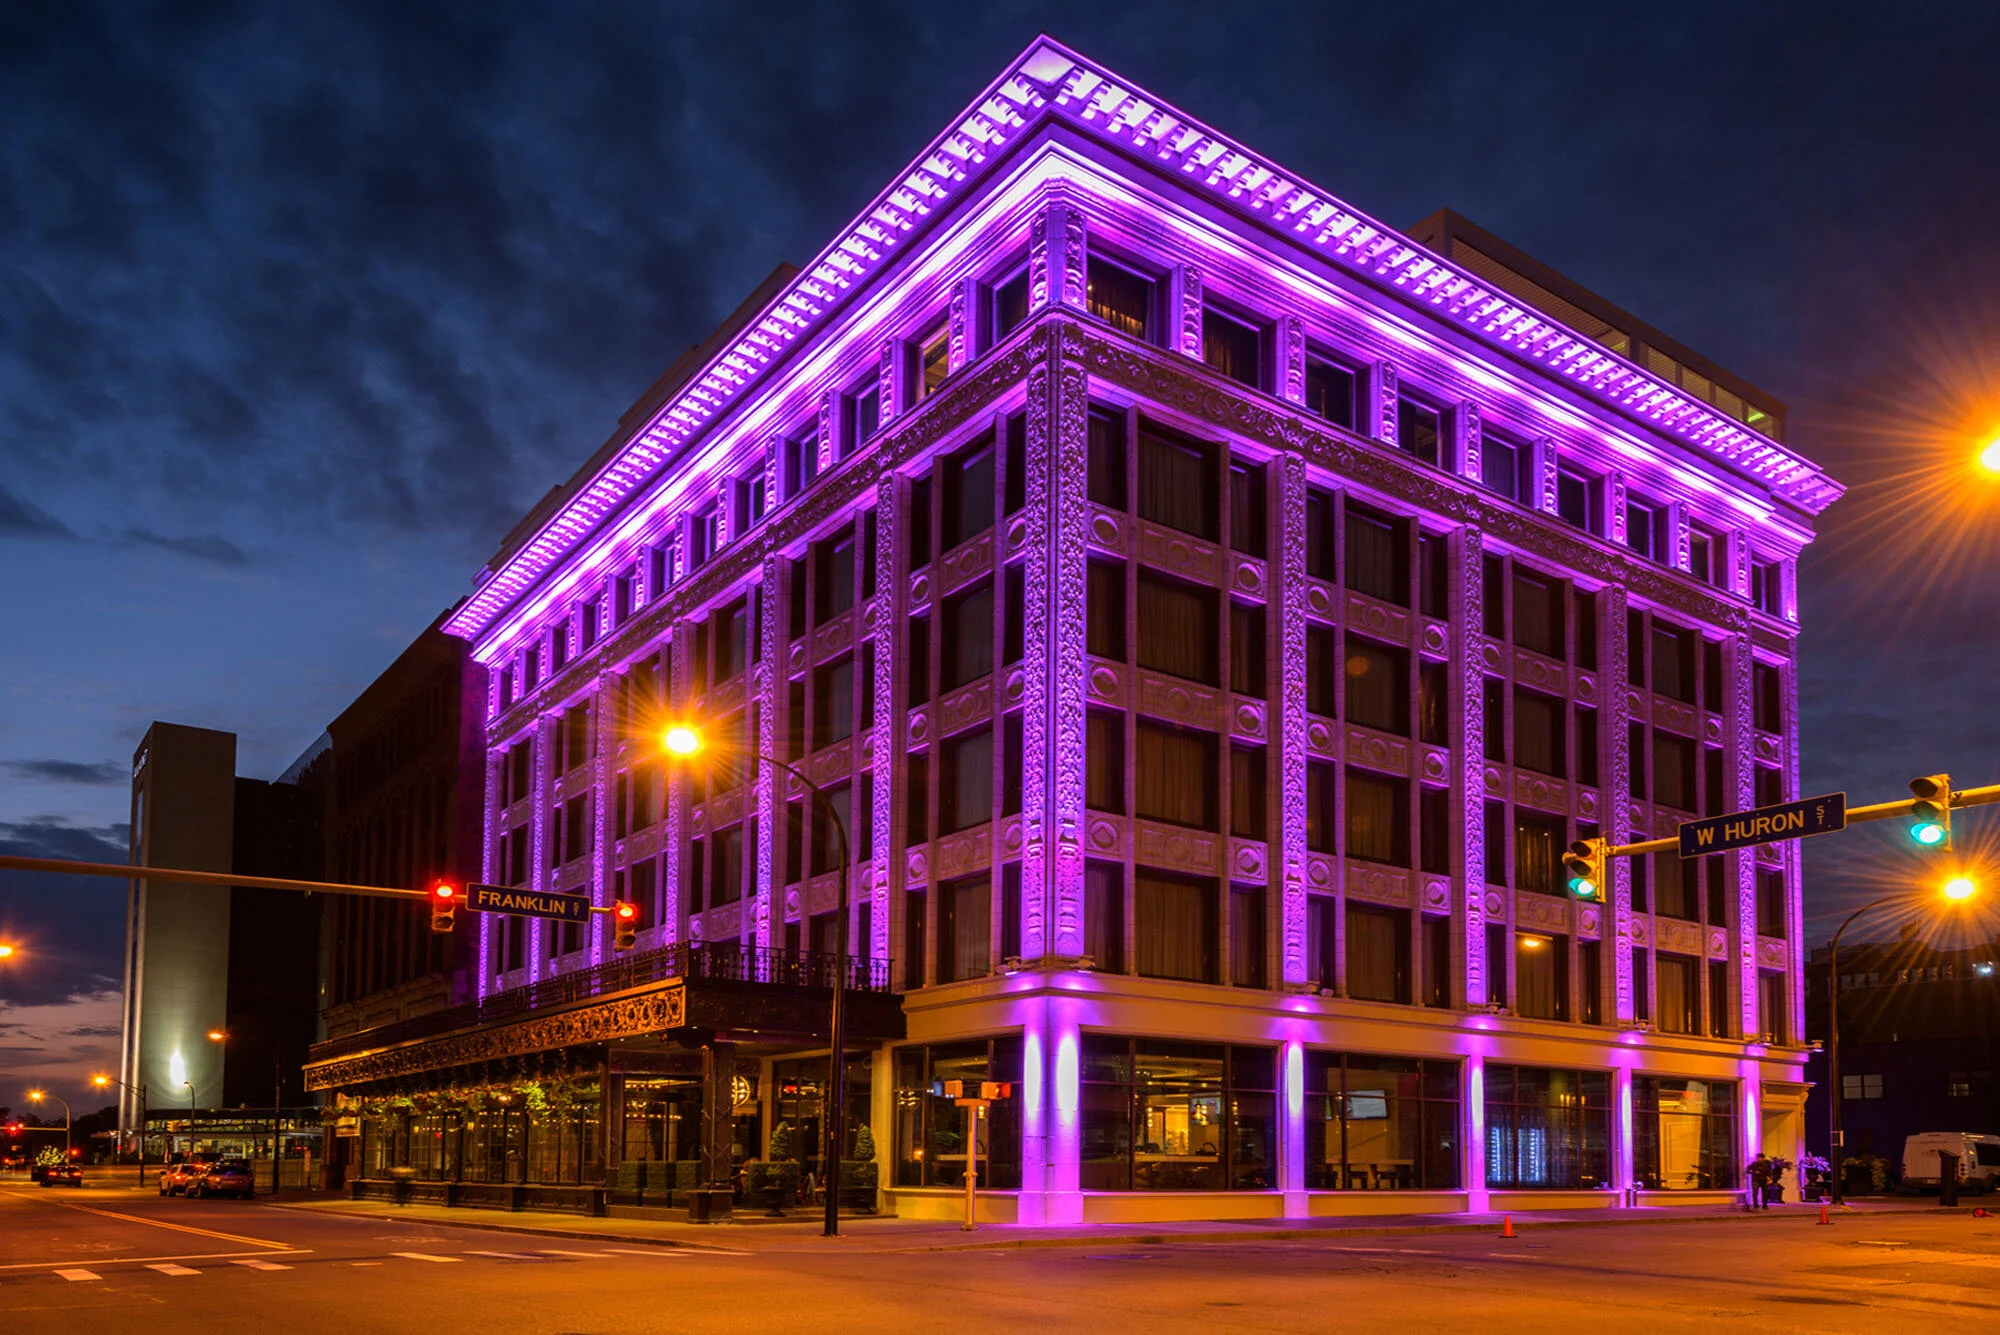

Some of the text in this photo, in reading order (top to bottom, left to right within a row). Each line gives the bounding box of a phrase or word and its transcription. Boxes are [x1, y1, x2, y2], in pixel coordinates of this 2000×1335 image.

[1697, 804, 1825, 847] W HURON ST
[478, 890, 566, 915] FRANKLIN
